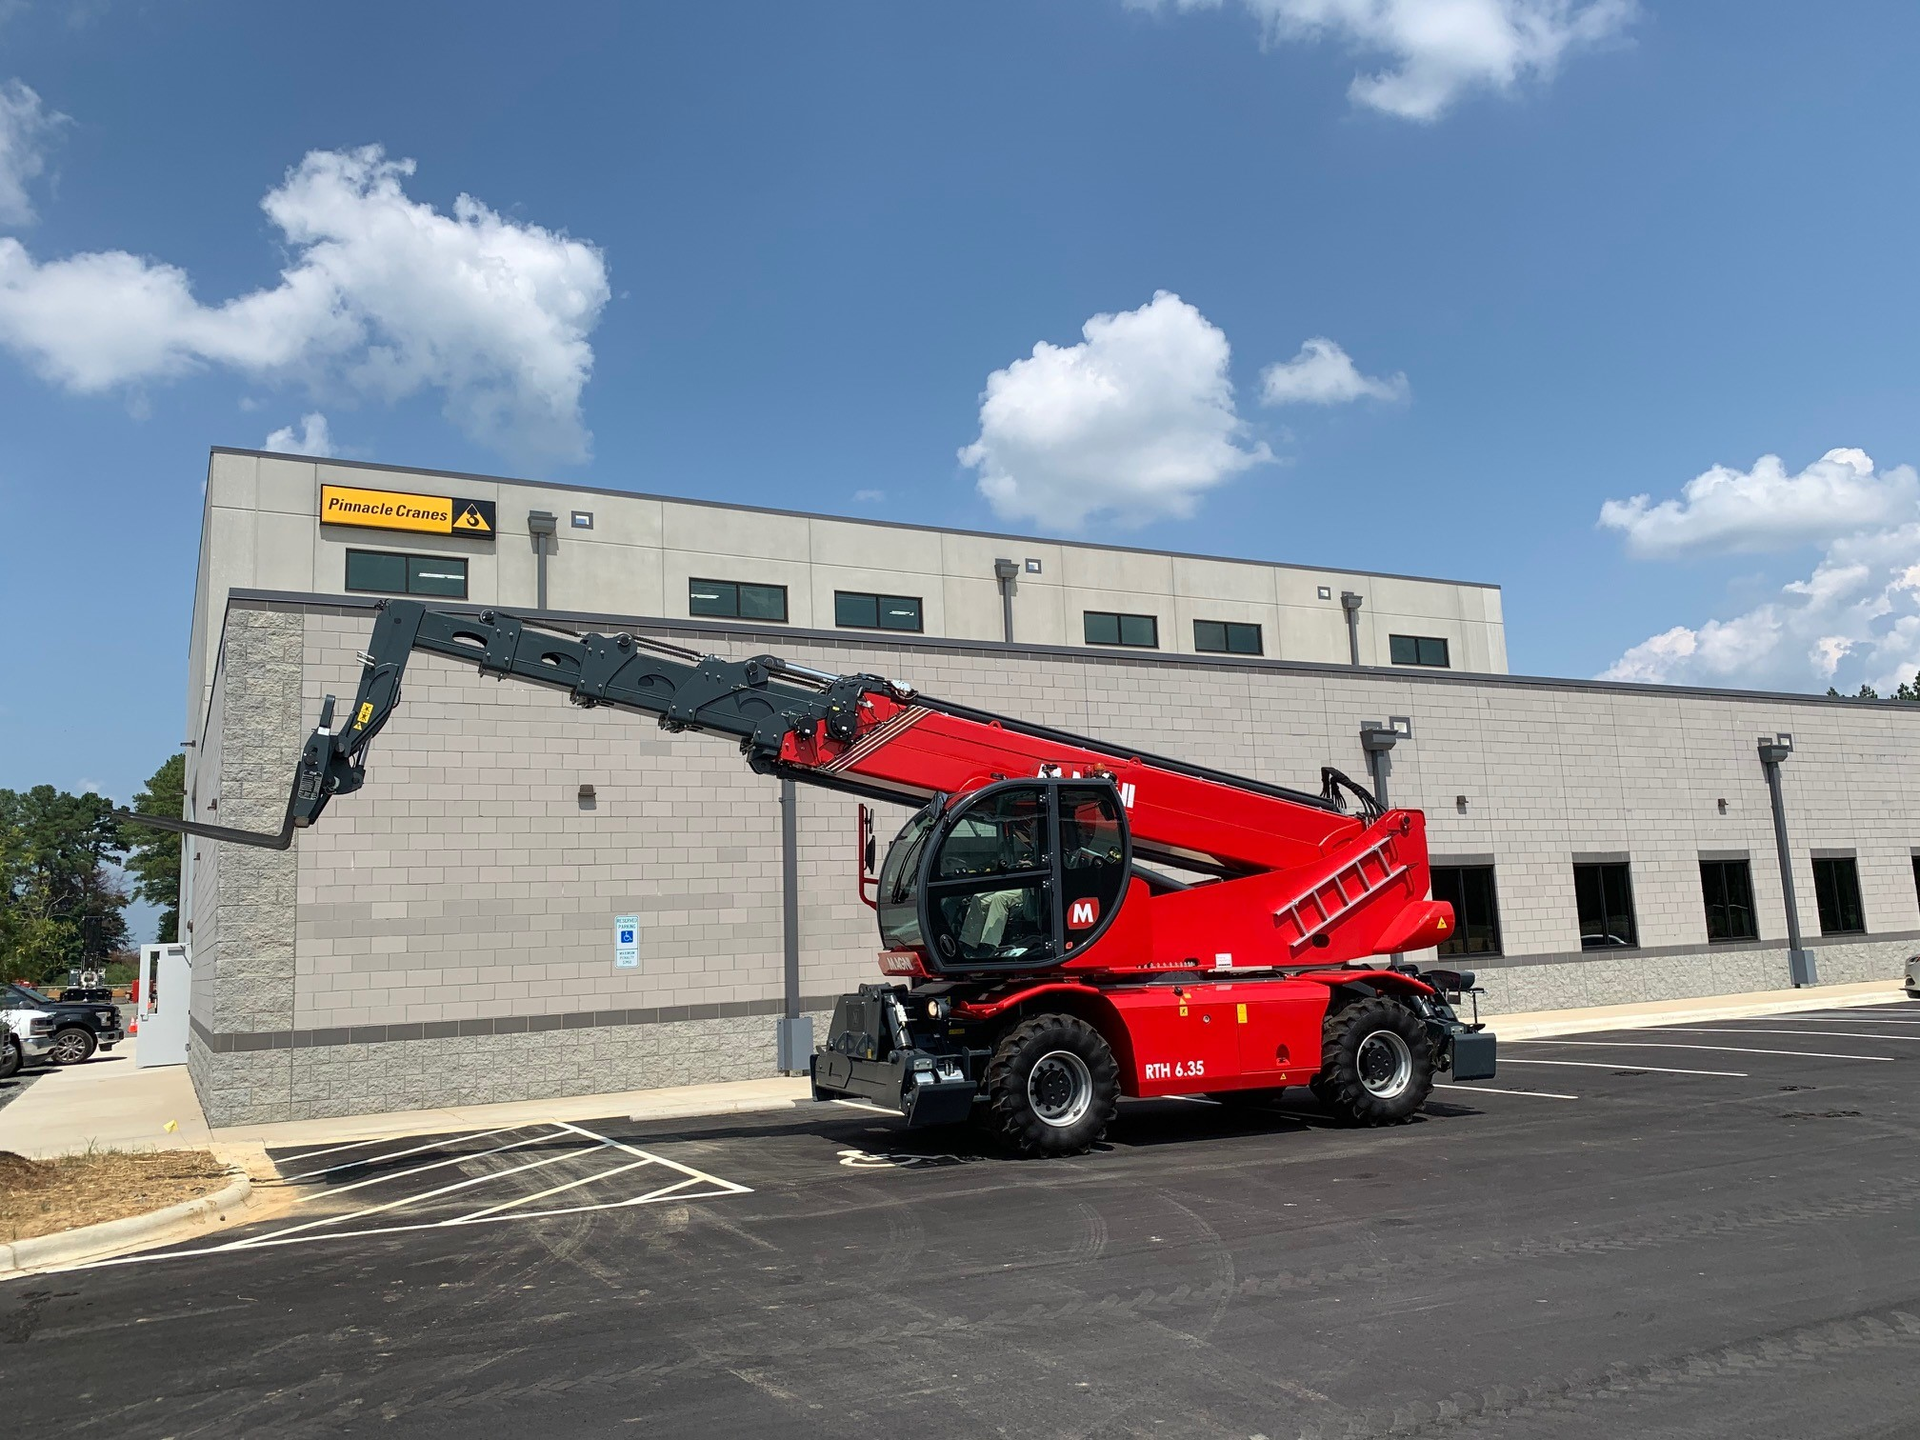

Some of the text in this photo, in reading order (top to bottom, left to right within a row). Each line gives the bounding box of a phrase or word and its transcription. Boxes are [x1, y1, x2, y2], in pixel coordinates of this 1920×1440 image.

[328, 498, 448, 522] Pinnacle Cranes
[1073, 903, 1094, 923] M
[1145, 1060, 1205, 1079] RTH 6.35
